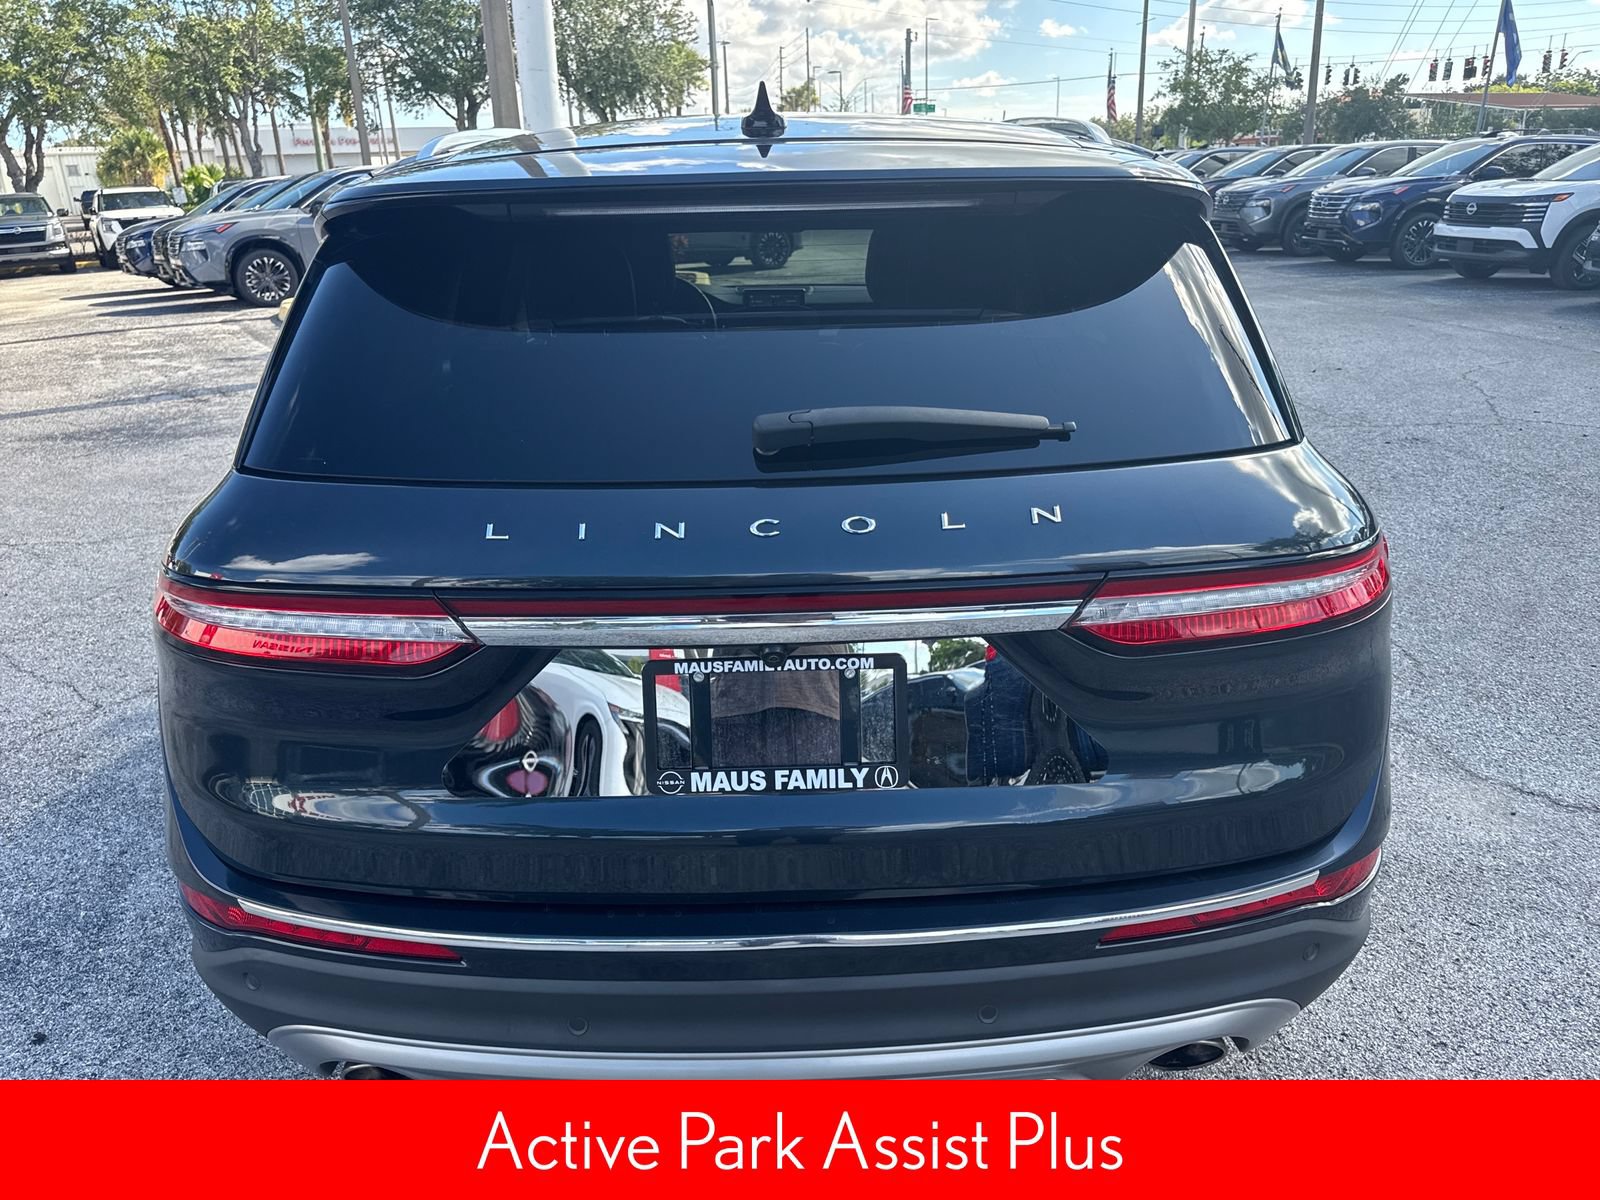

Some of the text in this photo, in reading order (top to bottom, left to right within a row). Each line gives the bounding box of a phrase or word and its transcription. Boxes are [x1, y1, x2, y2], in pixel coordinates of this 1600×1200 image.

[486, 504, 1062, 540] LINCOLN
[690, 768, 869, 792] MAUS FAMILY
